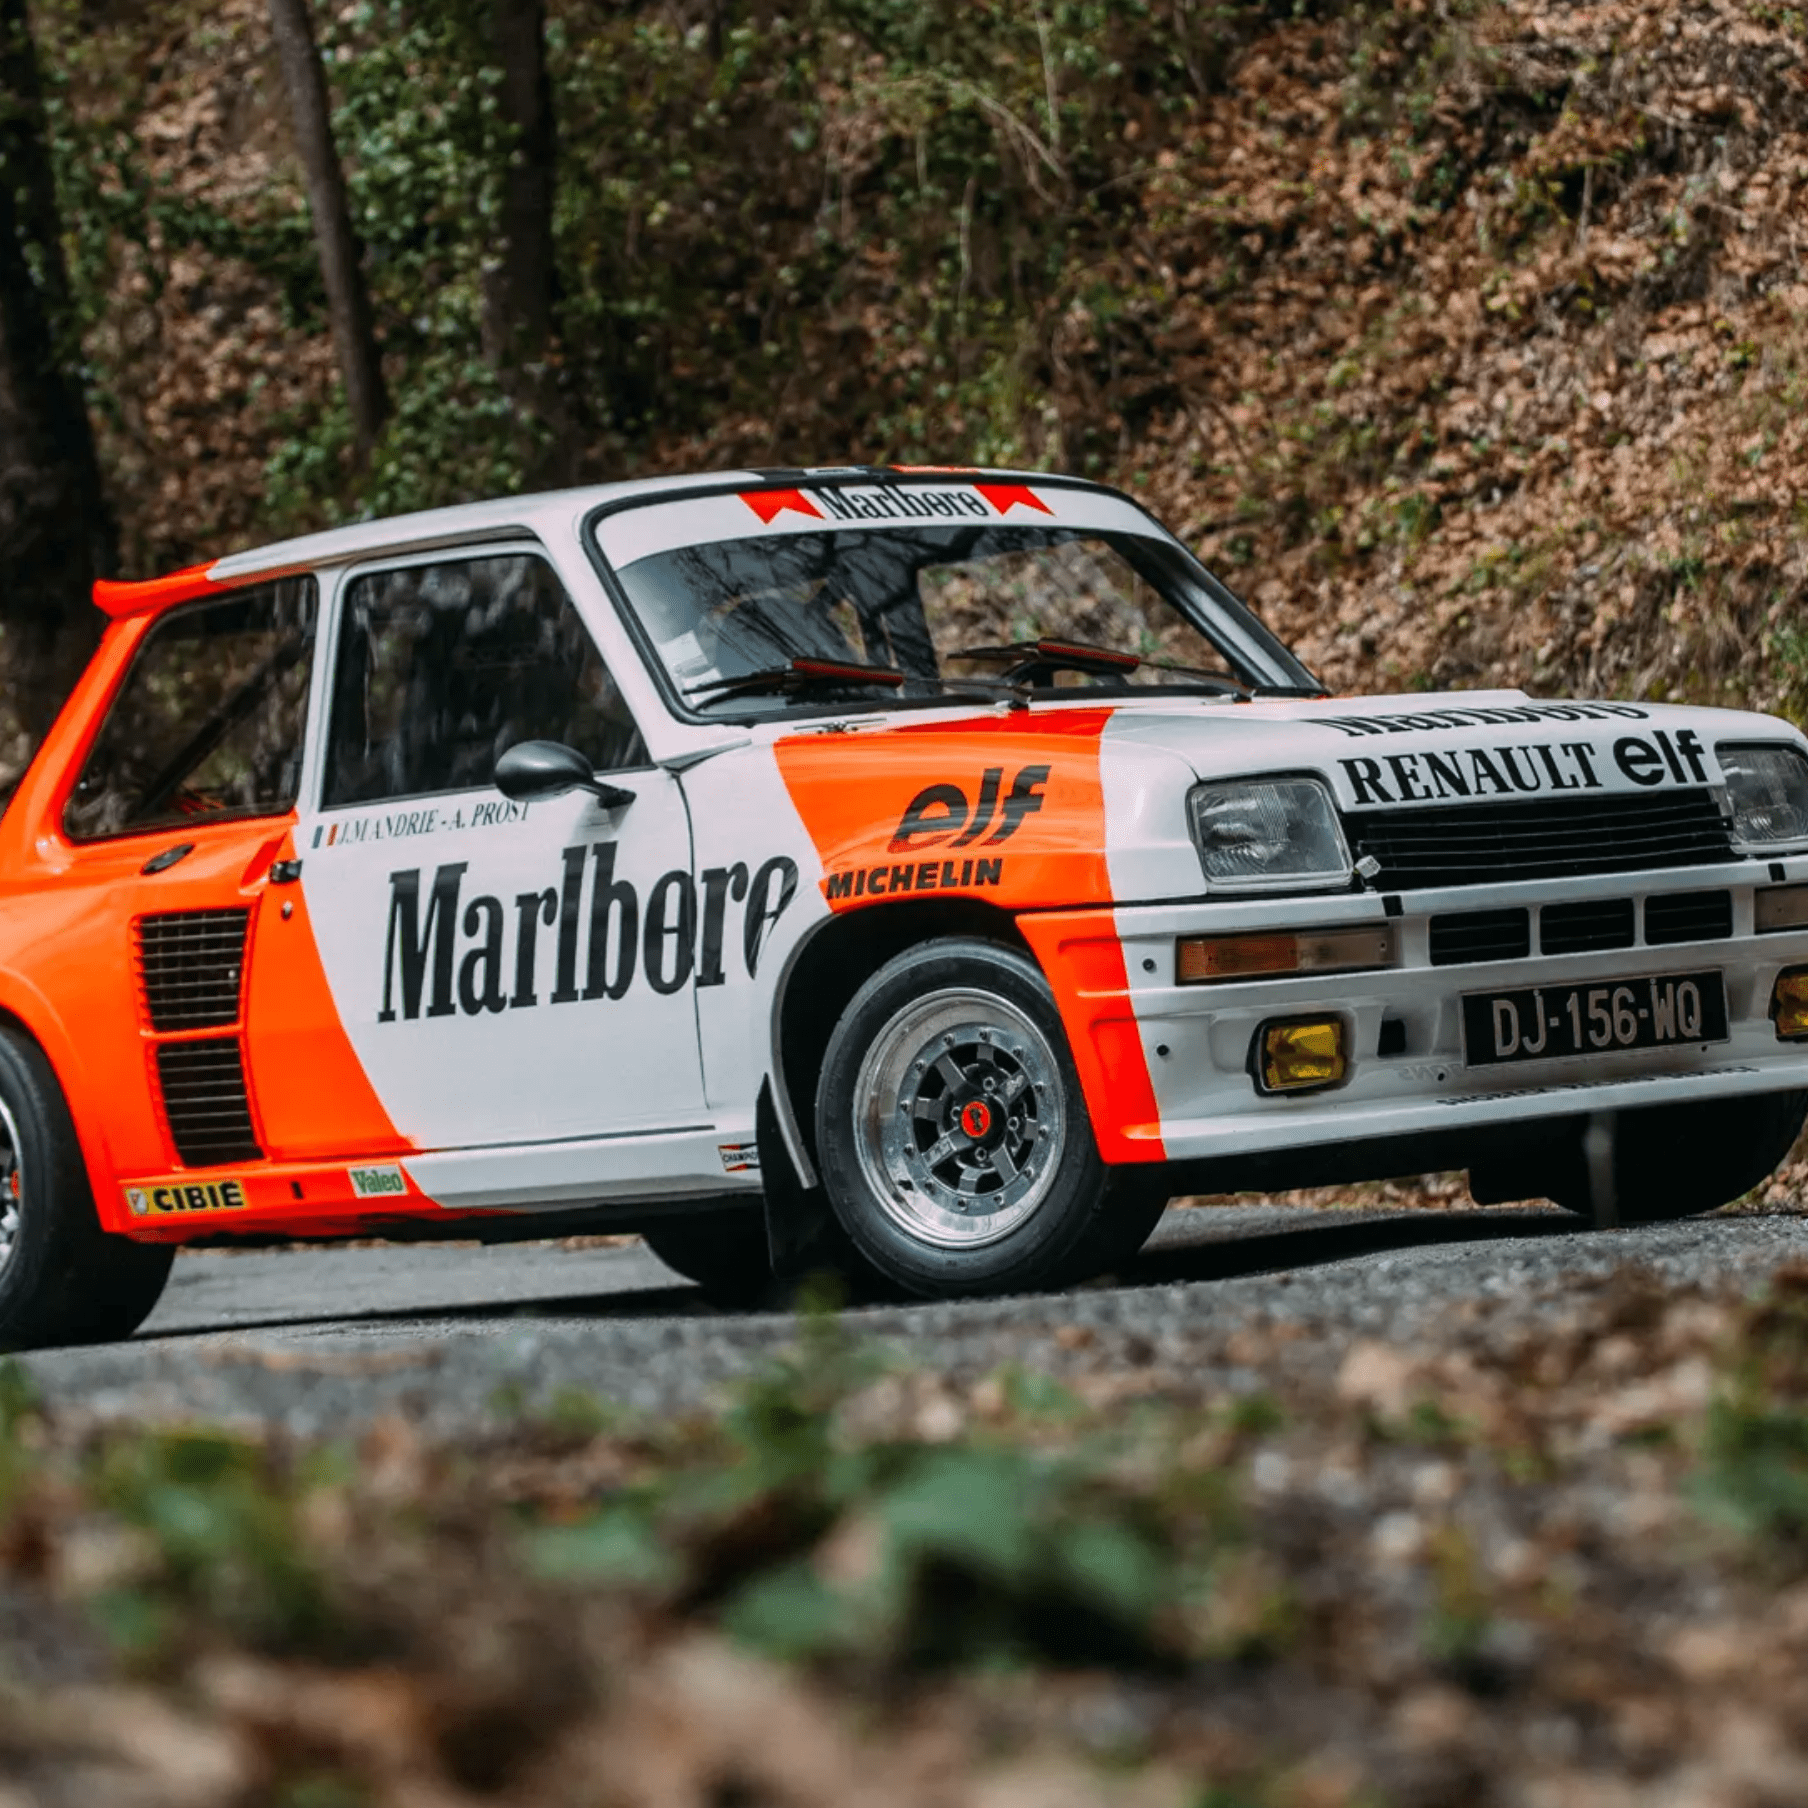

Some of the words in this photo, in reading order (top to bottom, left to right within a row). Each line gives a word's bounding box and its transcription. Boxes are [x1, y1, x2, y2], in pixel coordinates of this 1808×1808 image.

[808, 483, 990, 520] Marlboro
[1336, 742, 1602, 805] RENAULT
[1612, 729, 1709, 786] elf
[887, 764, 1052, 854] elf
[826, 858, 1003, 900] MICHELIN
[378, 840, 799, 1023] Marlboro
[1492, 978, 1701, 1057] DJ-156-WQ
[352, 1170, 403, 1194] Valeo
